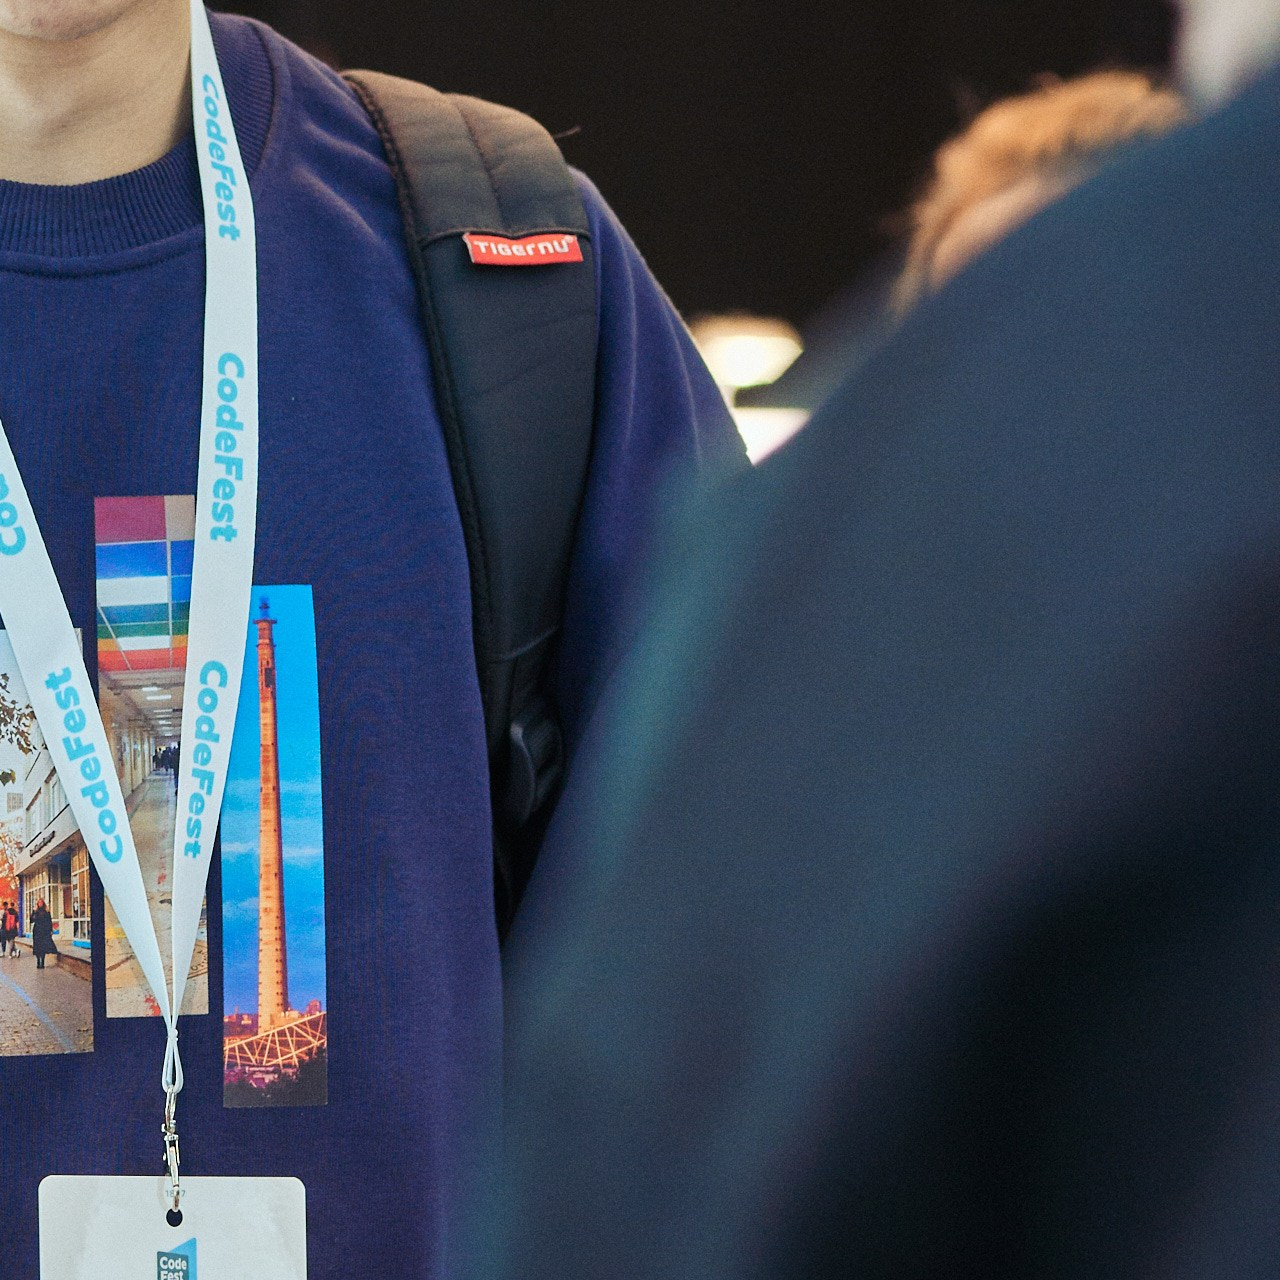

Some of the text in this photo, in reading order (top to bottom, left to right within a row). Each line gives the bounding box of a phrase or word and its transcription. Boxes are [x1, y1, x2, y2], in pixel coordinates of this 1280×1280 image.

[201, 73, 241, 241] CodeFest
[209, 352, 245, 543] CodeFest
[44, 666, 124, 864] CodeFest
[183, 660, 229, 859] CodeFest
[159, 1256, 188, 1270] Code
[164, 1189, 187, 1198] 187
